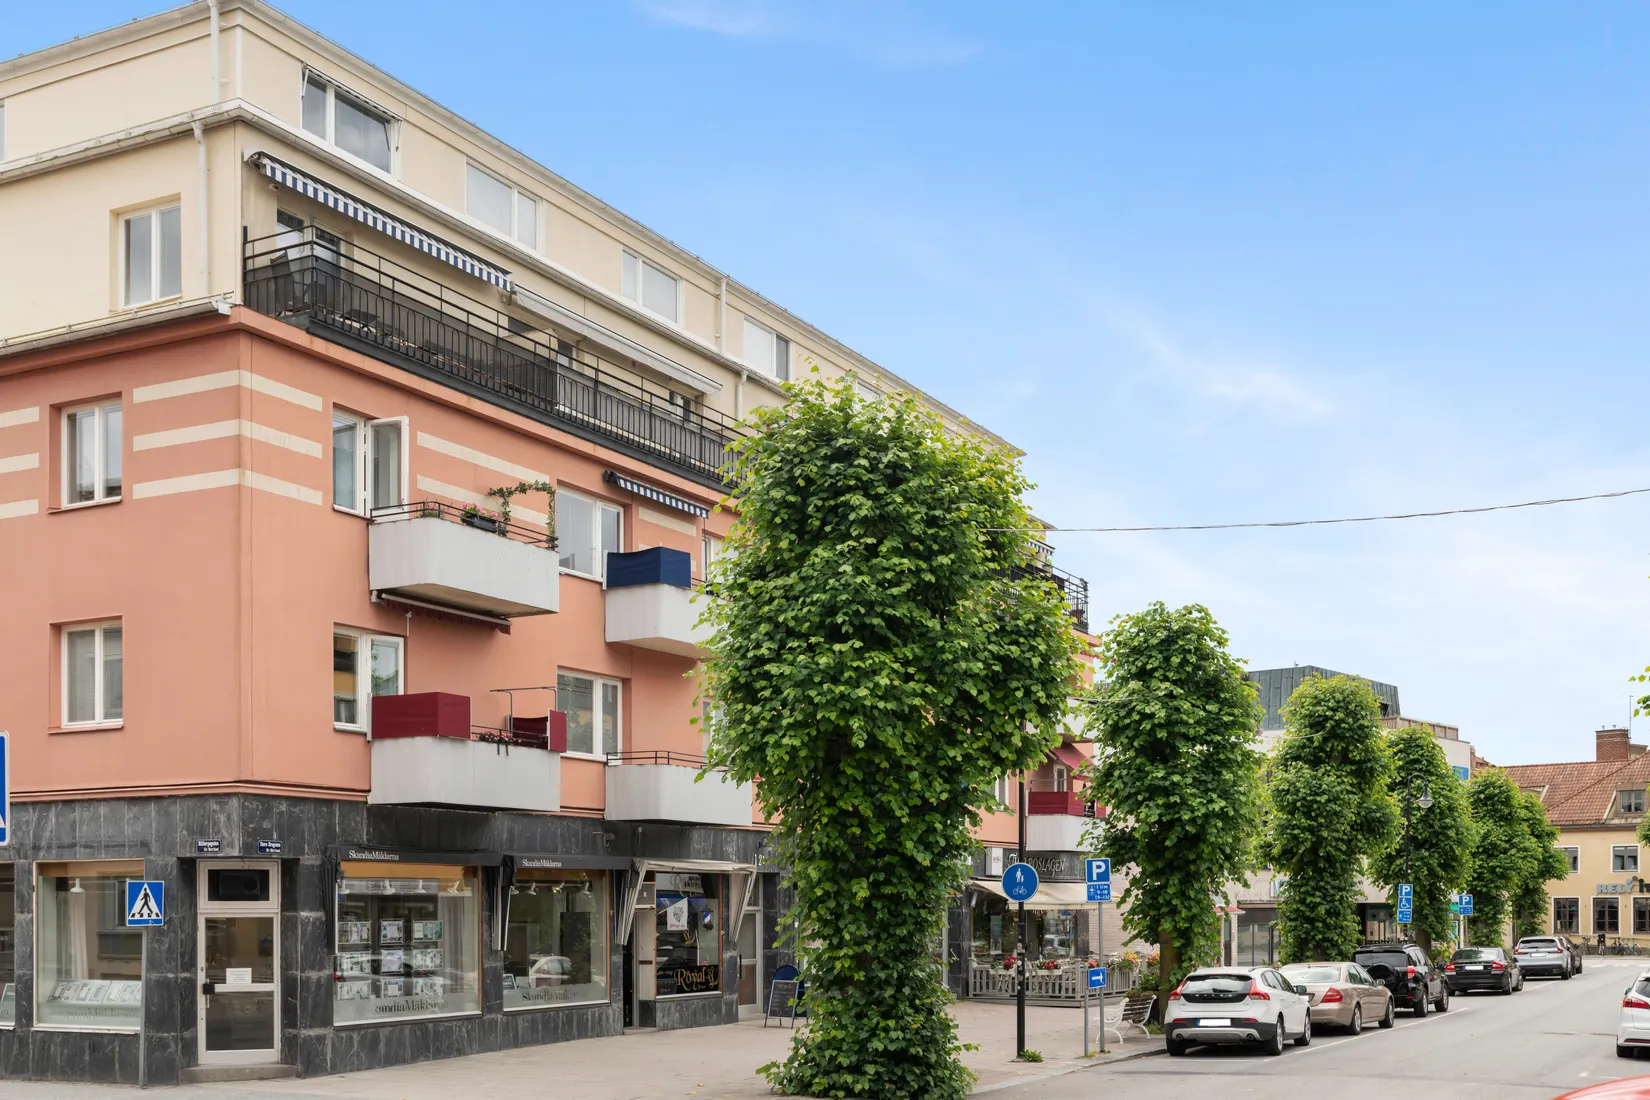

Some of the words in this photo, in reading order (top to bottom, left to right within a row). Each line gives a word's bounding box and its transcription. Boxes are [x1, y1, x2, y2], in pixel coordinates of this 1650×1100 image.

[348, 849, 400, 861] SkandiaMäklarna
[522, 858, 562, 868] SkandiaMäklarna
[1092, 861, 1106, 881] P
[1402, 885, 1411, 896] P
[1597, 879, 1634, 894] RELY
[1462, 896, 1470, 905] P
[674, 967, 706, 991] Royal
